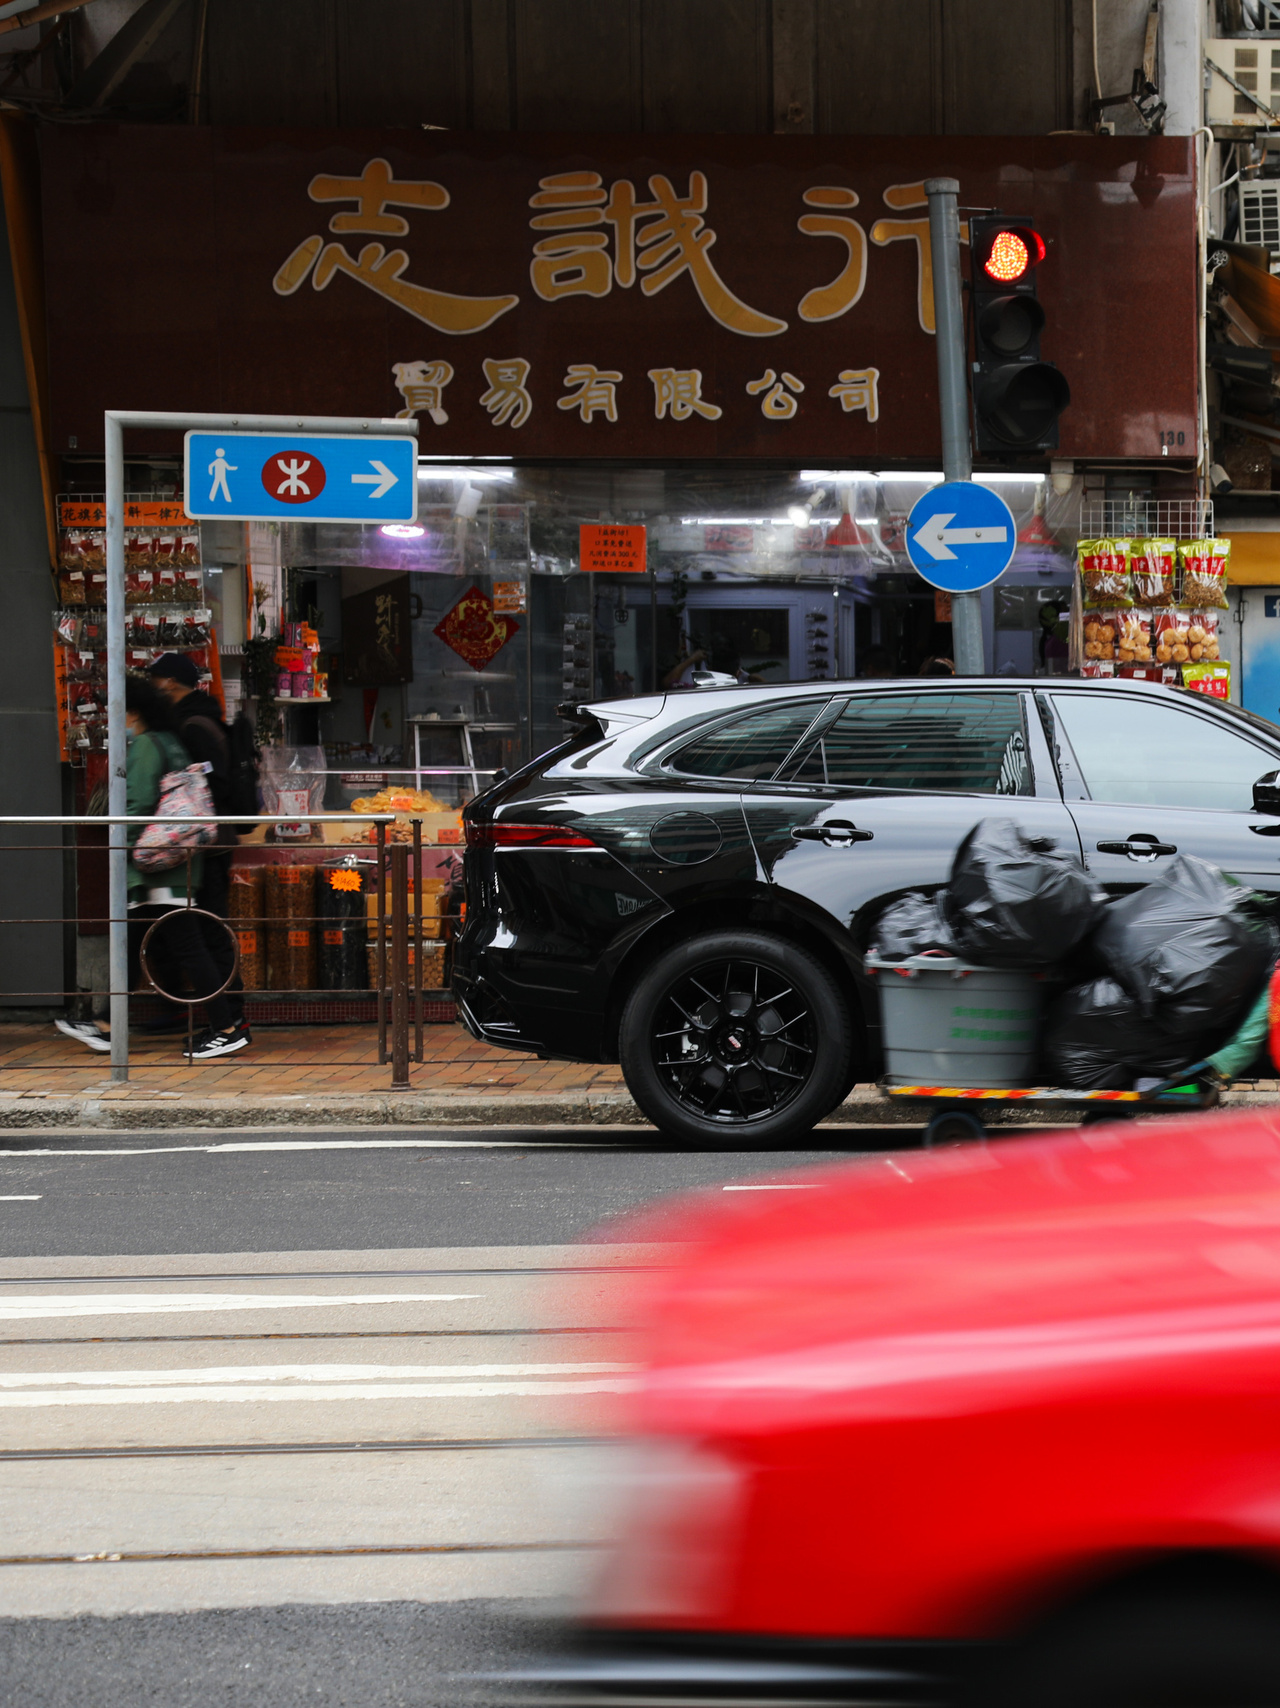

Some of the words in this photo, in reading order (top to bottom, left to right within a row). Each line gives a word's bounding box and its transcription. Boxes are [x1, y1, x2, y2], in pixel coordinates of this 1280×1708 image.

[391, 356, 881, 429] 貿易有限公司
[1160, 430, 1185, 446] 130
